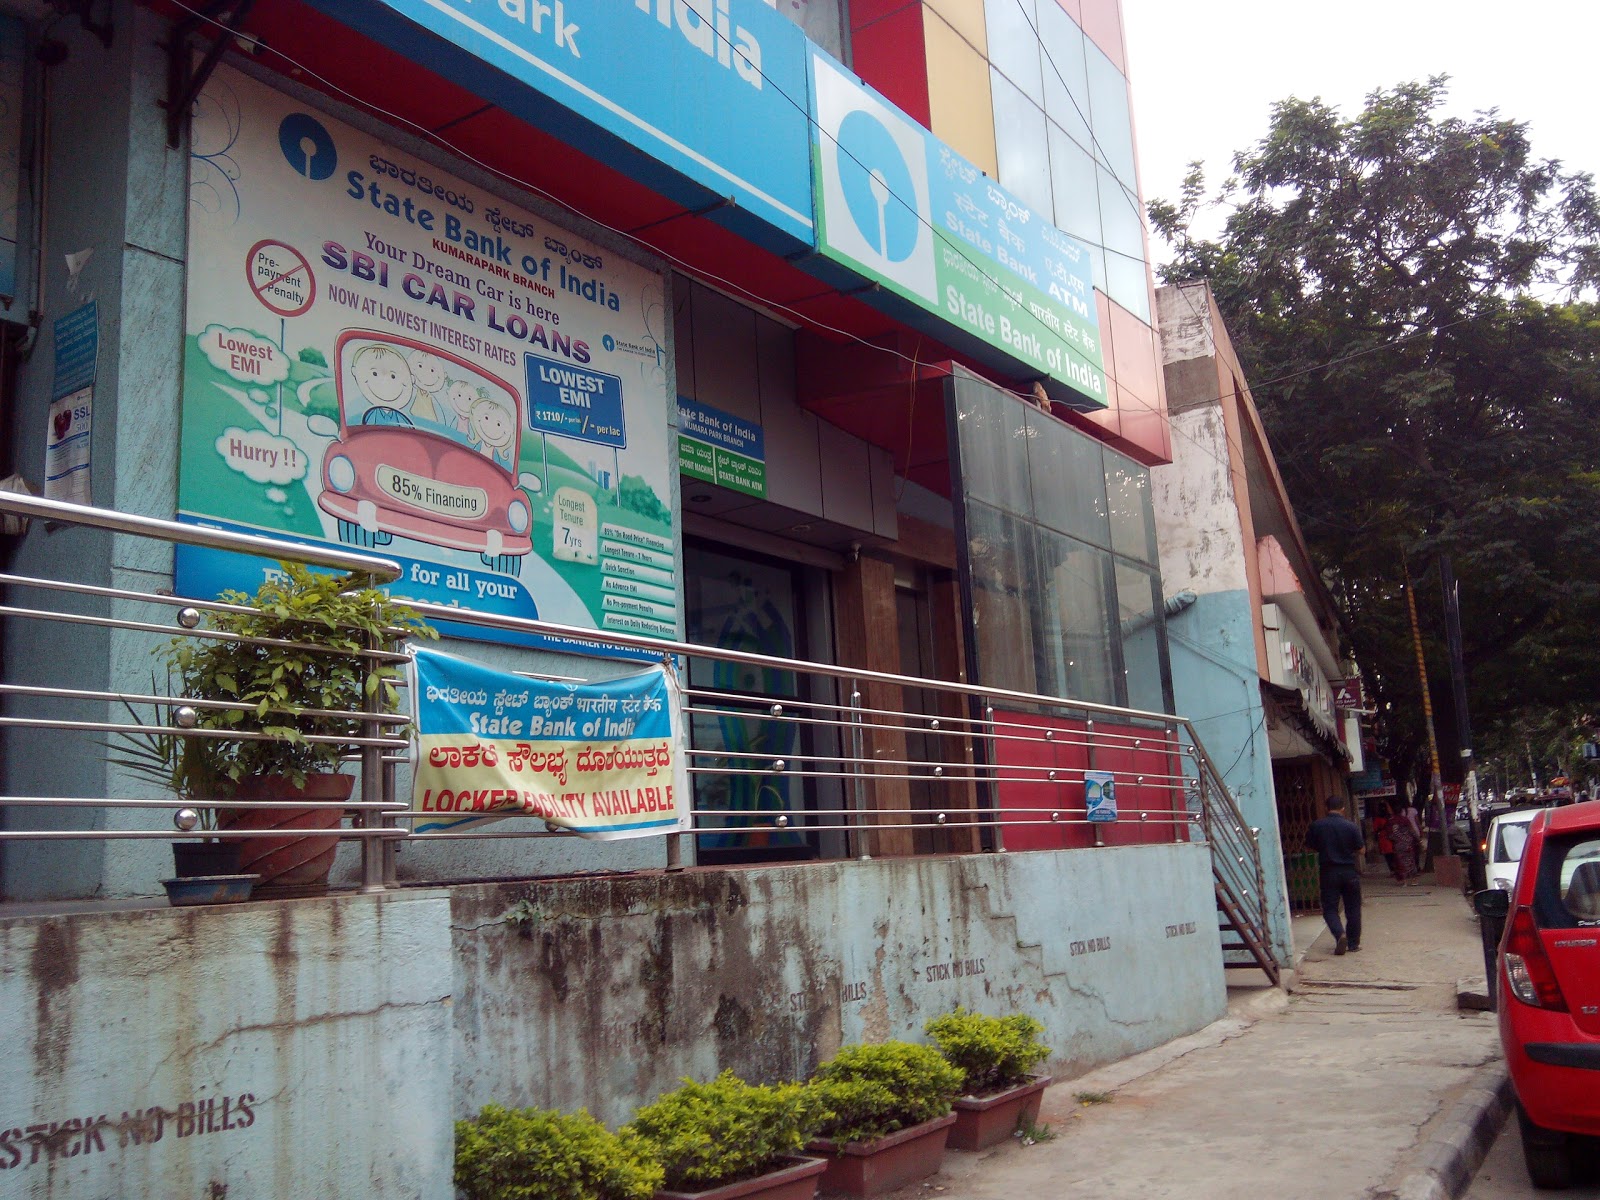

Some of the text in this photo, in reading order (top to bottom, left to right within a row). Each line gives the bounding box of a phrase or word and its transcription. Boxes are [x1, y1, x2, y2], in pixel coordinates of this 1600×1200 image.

[465, 0, 581, 59] ark
[369, 154, 602, 270] ಭಾರತೀಯ ಸ್ಟೇಟ್ ಬ್ಯಾಂಕ್
[346, 170, 621, 312] State Bank of India
[258, 265, 302, 288] payment
[364, 231, 560, 325] Your Dream Car is here
[432, 238, 555, 299] KUMARAPARK BRANCH
[945, 210, 1089, 318] State Bank ATM
[267, 284, 304, 306] Penalty
[321, 240, 592, 365] SBI CAR LOANS
[329, 284, 517, 366] NOW AT LOWEST INTEREST RATES
[1030, 301, 1060, 333] भारतीय
[1063, 319, 1079, 343] स्टेट
[218, 333, 273, 361] Lowest
[946, 284, 1102, 394] State Bank of India
[230, 355, 261, 376] EMI
[539, 365, 605, 394] LOWEST
[559, 387, 591, 409] EMI
[597, 425, 608, 435] per
[609, 425, 621, 436] lac
[684, 420, 744, 448] KUMARA PARK BRANCH
[698, 411, 720, 429] Bank
[722, 422, 733, 434] of
[734, 424, 756, 442] India
[229, 438, 297, 468] Hurry !!
[392, 475, 478, 512] 85% Financing
[718, 470, 763, 492] STATE BANK ATM
[558, 494, 586, 513] Longest
[560, 508, 583, 526] Tenure
[604, 545, 620, 556] Longest
[621, 548, 635, 559] Tenure
[605, 562, 617, 571] Quick
[410, 563, 440, 586] for
[445, 571, 471, 593] all
[475, 579, 518, 600] your
[612, 581, 629, 591] Advance
[493, 688, 529, 716] ಸ್ಟೇಟ್
[533, 691, 574, 718] ಬ್ಯಾಂಕ್
[576, 693, 618, 714] भारतीय
[621, 693, 641, 714] स्टेट
[469, 711, 523, 736] State
[529, 715, 577, 738] Bank
[582, 715, 602, 737] of
[506, 743, 569, 786] ಸೌಲಭ್ಯ
[576, 741, 671, 777] ದೊರೆಯುತ್ತದೆ
[592, 784, 675, 818] AVAILABLE
[1069, 936, 1111, 957] STICK NO BILLS
[925, 957, 986, 983] STICK NO BILLS
[842, 981, 868, 1004] BILLS
[176, 1092, 256, 1139] BILLS
